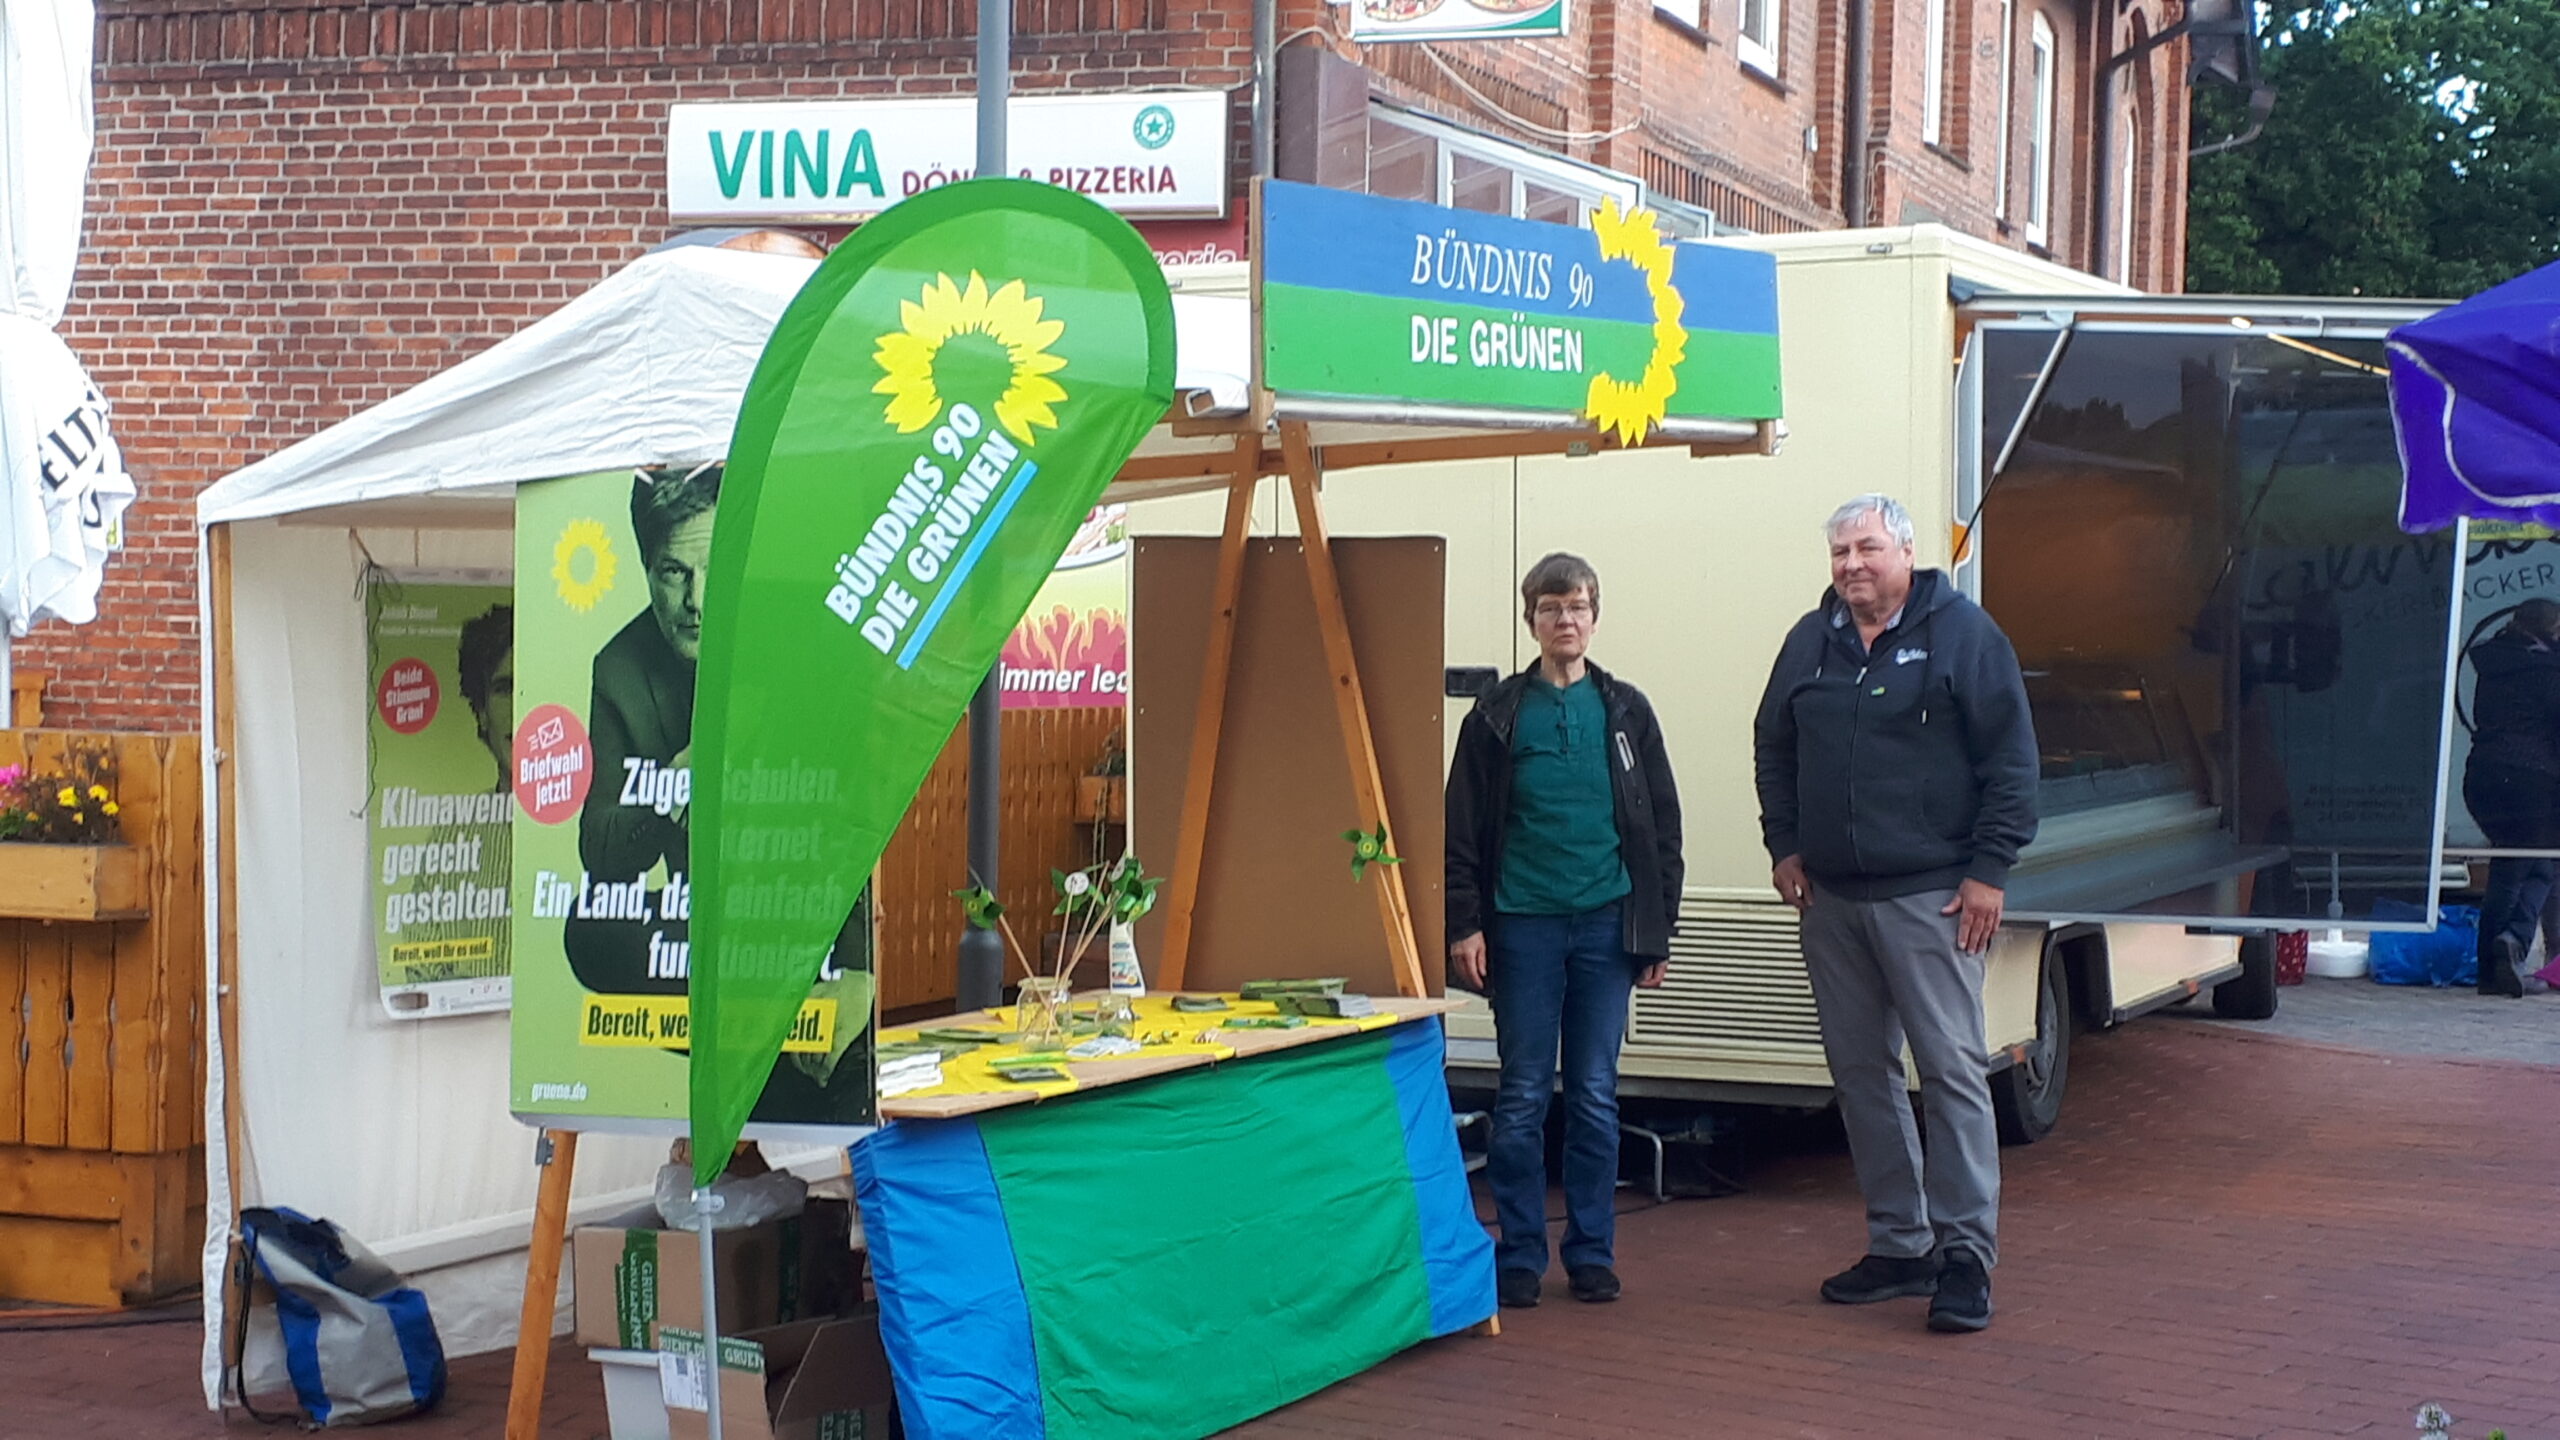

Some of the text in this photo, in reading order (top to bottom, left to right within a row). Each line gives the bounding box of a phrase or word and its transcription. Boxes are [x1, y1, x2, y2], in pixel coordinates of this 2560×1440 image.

[708, 129, 885, 199] VINA
[1048, 165, 1177, 194] PIZZERIA
[1411, 228, 1594, 310] BÜNDNIS 90
[1411, 312, 1583, 374] DIE GRÜNEN
[824, 402, 982, 625] BÜNDNIS 90
[860, 429, 1020, 655] DIE GRÜNEN
[1000, 661, 1065, 693] immer
[520, 744, 583, 785] Briefwahl
[383, 831, 483, 885] gerecht
[386, 880, 512, 933] gestalten.
[533, 871, 572, 918] Ein
[577, 871, 653, 925] Land,
[660, 872, 690, 920] da
[588, 1005, 824, 1041] Bereit, we eid.
[532, 1081, 587, 1102] gruene.de
